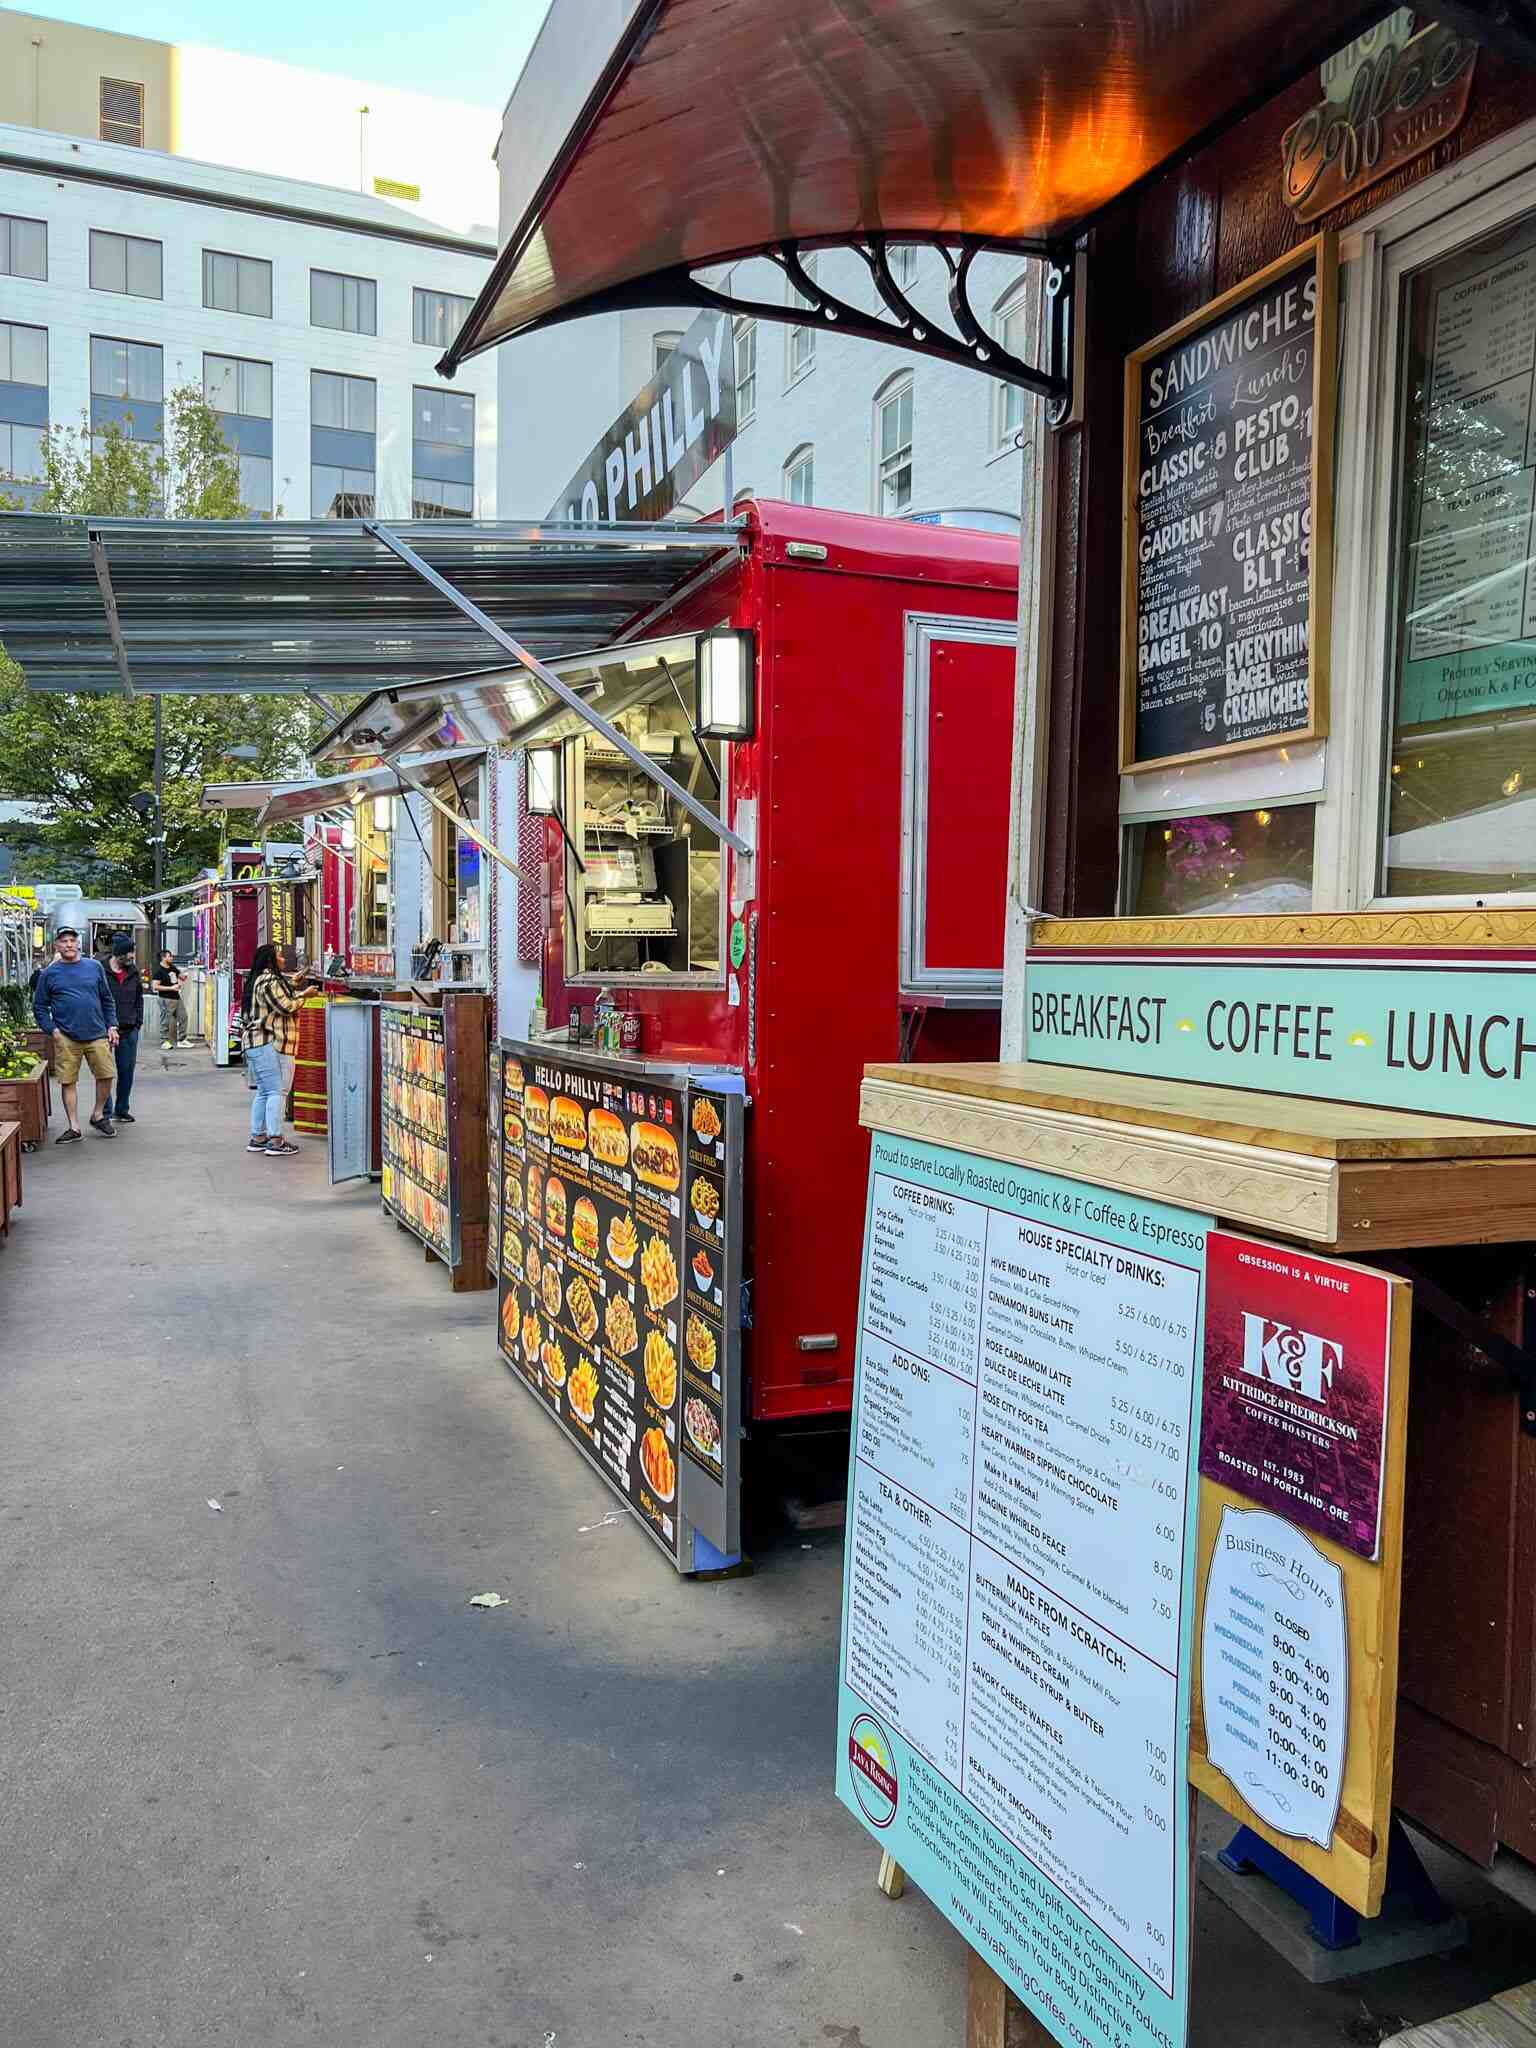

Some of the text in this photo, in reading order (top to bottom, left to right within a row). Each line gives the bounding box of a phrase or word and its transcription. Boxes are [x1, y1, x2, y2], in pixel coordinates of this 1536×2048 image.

[1149, 275, 1317, 411] SANDWICHES
[1231, 348, 1307, 410] Lunch
[606, 314, 725, 521] PHILLY
[1144, 398, 1216, 456] Breakfast
[1234, 395, 1300, 454] PESTO
[1234, 439, 1291, 484] CLUB
[1139, 586, 1229, 644] BREAKFAST
[1139, 628, 1192, 674] BAGEL
[1225, 619, 1310, 674] EVERYTHIN
[1494, 656, 1536, 673] SERVIN
[1225, 661, 1276, 699] BAGEL
[1488, 679, 1498, 695] K
[1031, 991, 1167, 1046] BREAKFAST
[1206, 999, 1335, 1061] COFFEE
[535, 1065, 600, 1102] HELLO PHILLY
[875, 1143, 1204, 1257] Proud to serve Locally Roasted Organic K & F Coffee & Espresso
[892, 1184, 954, 1215] COFFEE DRINKS:
[990, 1256, 1050, 1289] HIVE MIND LATTE
[1018, 1226, 1165, 1288] HOUSE SPECIALTY DRINKS:
[1238, 1252, 1350, 1294] OBSESSION IS A VIRTUE
[988, 1290, 1073, 1335] CINNAMON BUNS LATTE
[892, 1352, 909, 1372] ADD
[984, 1357, 1065, 1407] DULCE DE LECHE LATTE
[985, 1338, 1072, 1389] ROSE CARDAMOM LATTE
[1239, 1311, 1344, 1405] K&F
[983, 1390, 1048, 1434] ROSE CITY FOG TEA
[1245, 1405, 1331, 1451] COFFEE ROASTERS
[981, 1424, 1118, 1512] HEART WARMER SIPPING CHOCOLATE
[1218, 1450, 1259, 1478] ROASTED
[1261, 1471, 1271, 1483] IN
[1329, 1503, 1352, 1525] ORE.
[1282, 1463, 1305, 1486] 1983
[878, 1481, 931, 1529] TEA OTHER:
[978, 1490, 1066, 1557] IMAGINE WHIRLED PEACE
[1155, 1522, 1175, 1543] 6.00
[1153, 1559, 1173, 1582] 8.00
[1226, 1533, 1335, 1610] Business Hours
[975, 1573, 1050, 1637] BUTTERMILK WAFFLES
[1006, 1573, 1126, 1674] MADE FROM SCRATCH:
[1151, 1598, 1171, 1621] 7.50
[1274, 1611, 1311, 1642] CLOSED
[981, 1611, 1070, 1690] FRUIT WHIPPED CREAM
[972, 1660, 1063, 1746] SAVORY CHEESE WAFFLES
[981, 1630, 1104, 1739] ORGANIC MAPLE SYRUP BUTTER
[968, 1755, 1052, 1841] REAL FRUIT SMOOTHIES
[1148, 1764, 1166, 1788] 7.00
[1143, 1803, 1165, 1832] 10.00
[907, 1814, 951, 1870] Concoctions
[953, 1861, 970, 1889] That
[971, 1880, 987, 1906] Will
[1031, 1944, 1052, 1976] Your
[908, 1775, 939, 1819] Through
[939, 1808, 952, 1830] our
[954, 1819, 1007, 1885] Commitment
[1020, 1886, 1045, 1922] Serve
[1047, 1914, 1072, 1949] Local
[1083, 1949, 1123, 2005] Organic
[909, 1756, 920, 1777] We
[920, 1765, 942, 1798] Strive
[1019, 1866, 1035, 1893] and
[1038, 1881, 1063, 1921] Uplift
[1066, 1912, 1083, 1939] our
[1085, 1928, 1145, 2002] Community
[907, 1794, 934, 1832] Provide
[1031, 1922, 1049, 1951] and
[1051, 1941, 1076, 1983] Bring
[1078, 1969, 1132, 2036] Distinctive
[1146, 1920, 1165, 1949] 8.00
